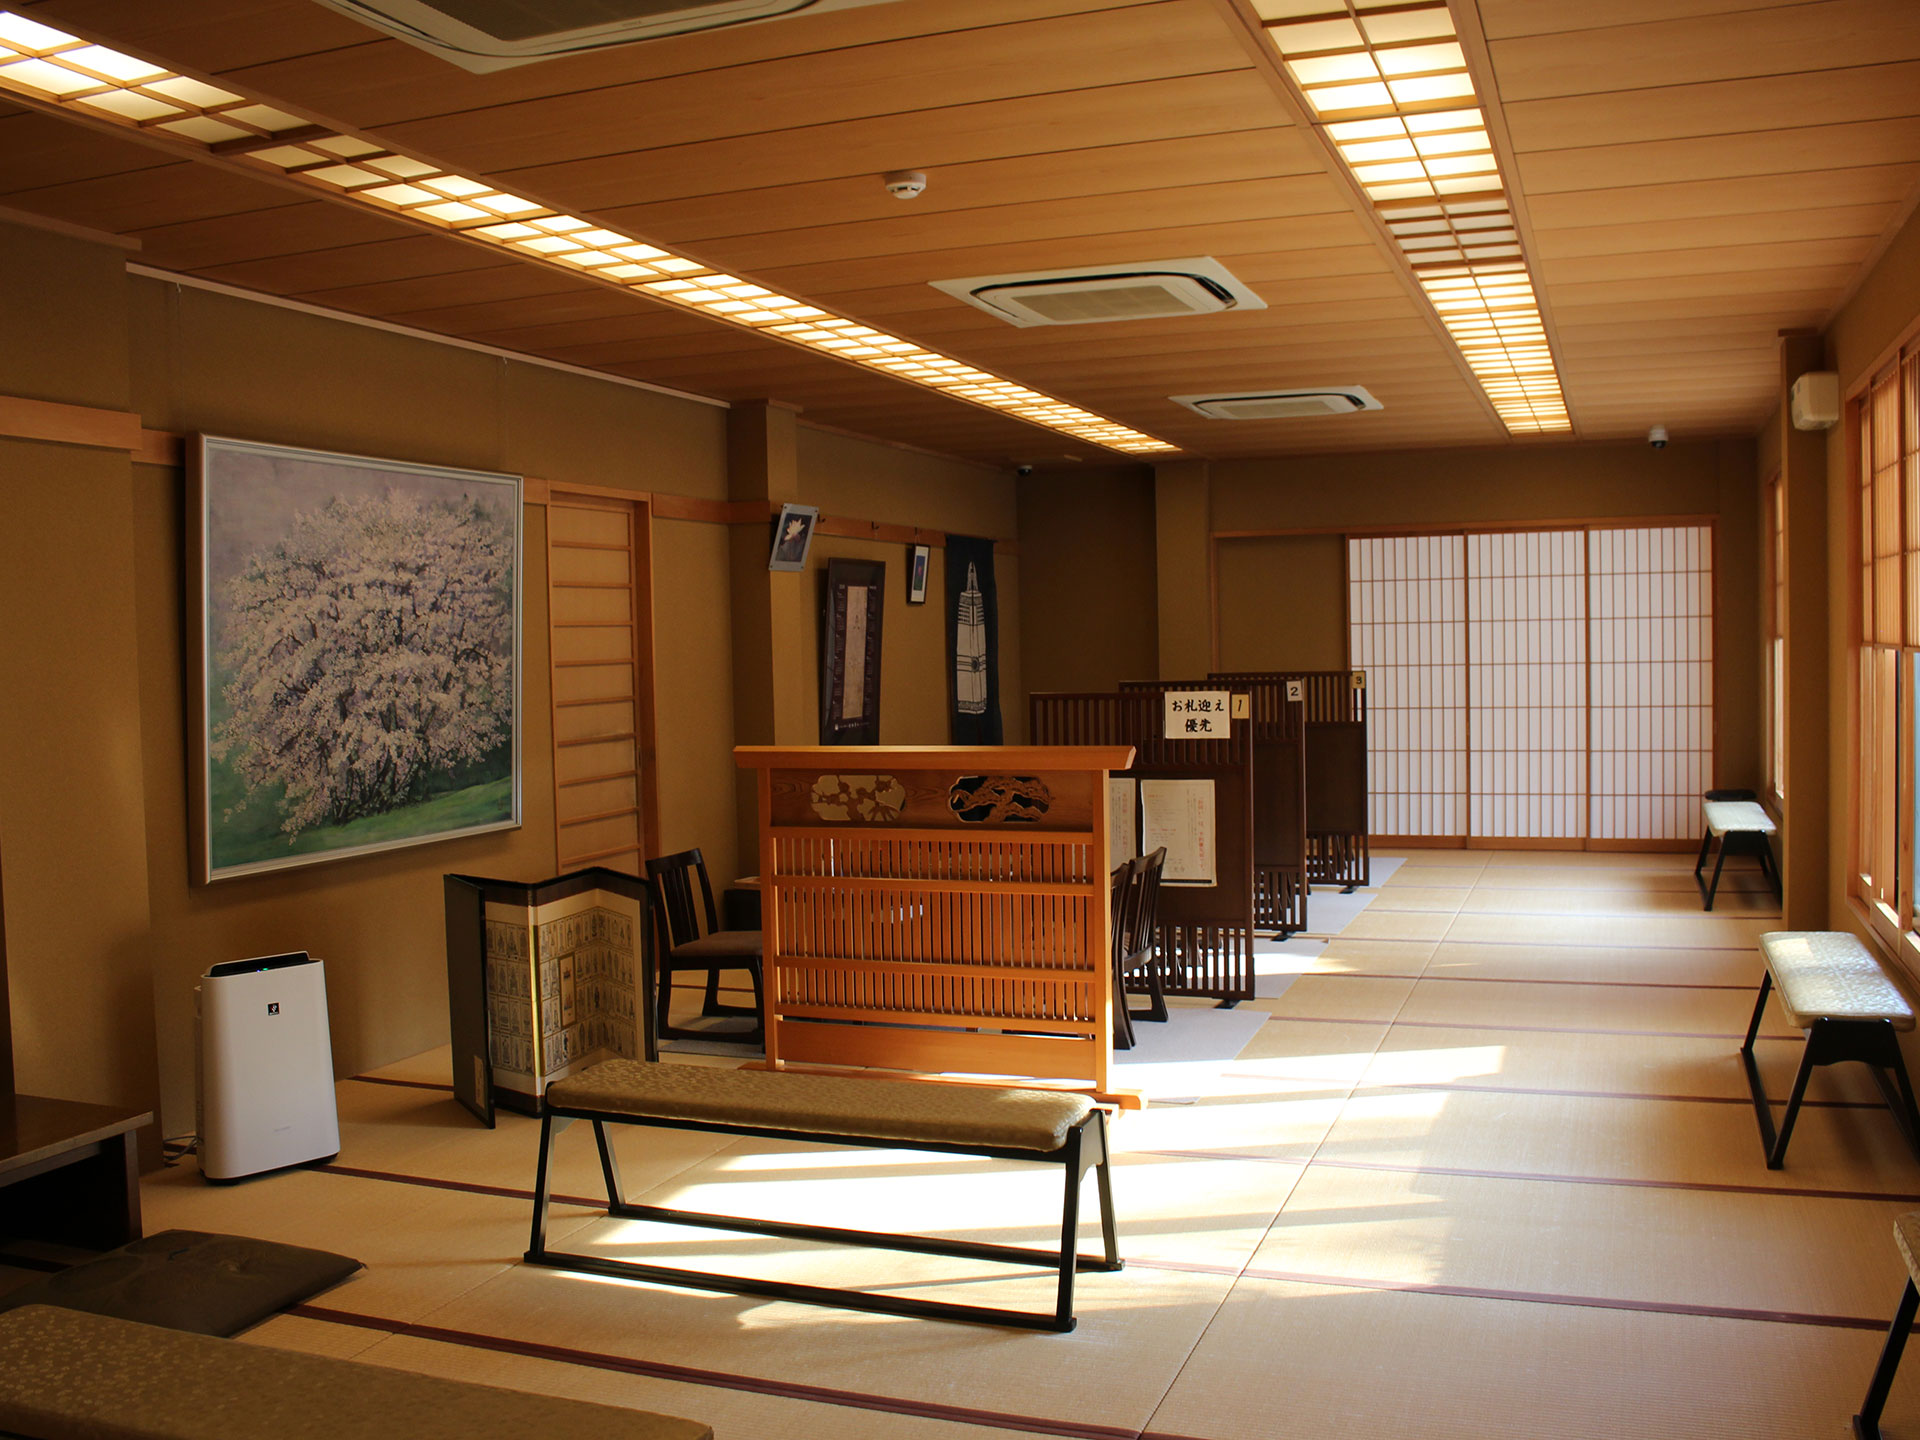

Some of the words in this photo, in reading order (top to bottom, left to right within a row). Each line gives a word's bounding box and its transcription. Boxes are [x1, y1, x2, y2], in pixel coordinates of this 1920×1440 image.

[1356, 676, 1363, 684] 3
[1290, 687, 1299, 697] 2
[1172, 699, 1225, 713] お札迎え
[1237, 699, 1243, 712] 1
[1185, 718, 1213, 733] 優先
